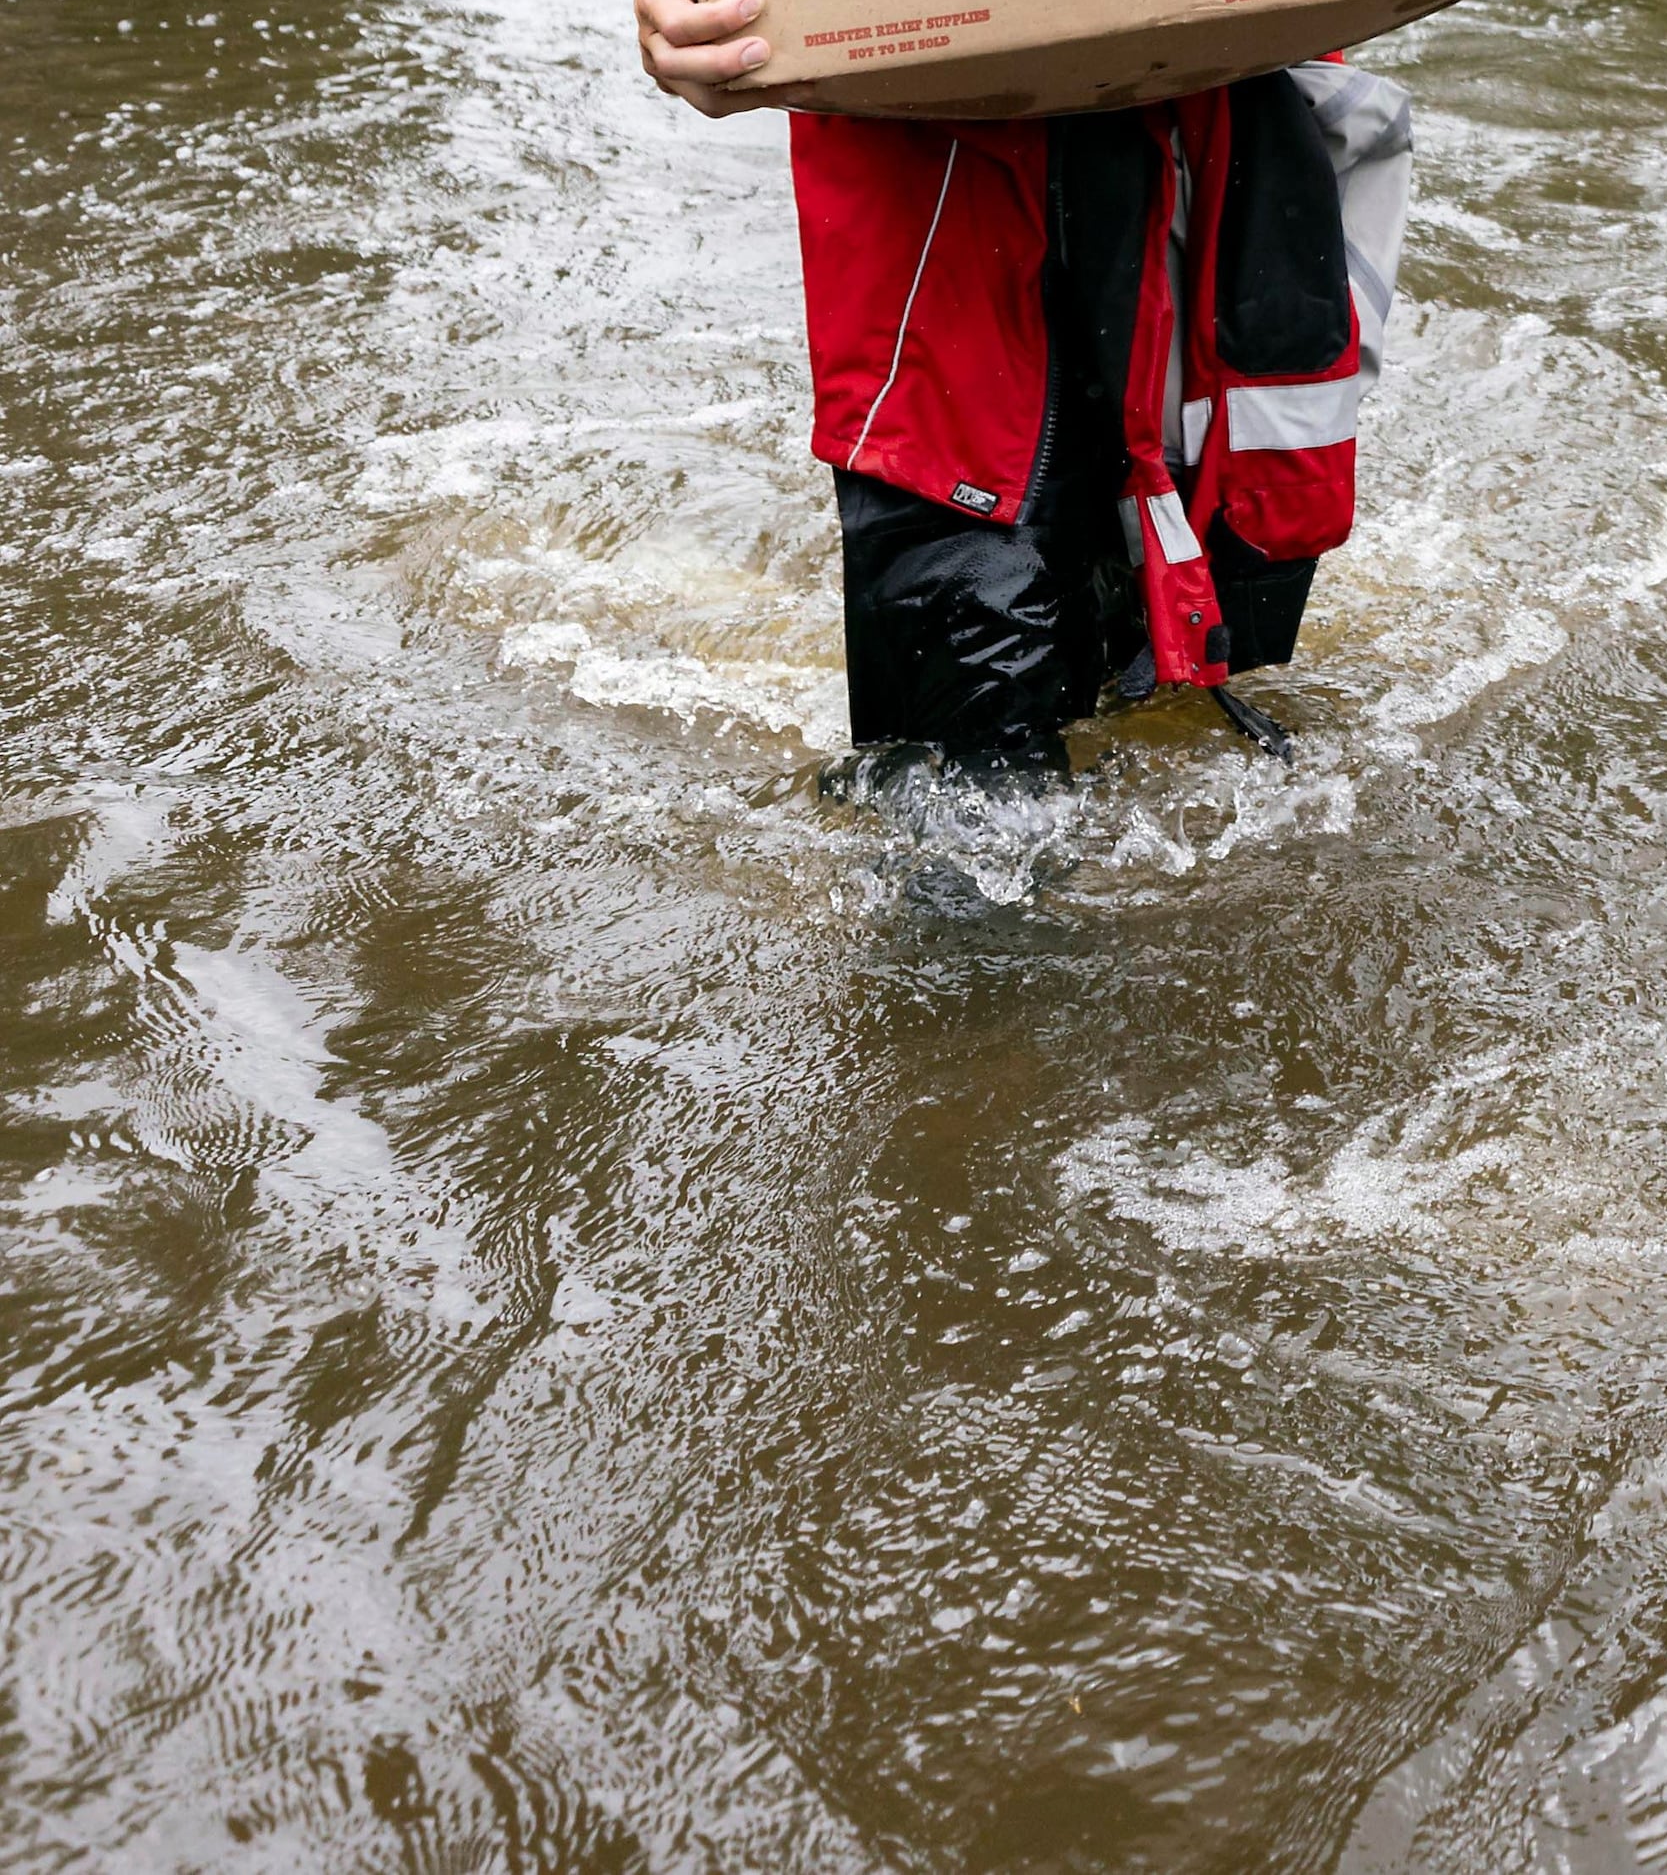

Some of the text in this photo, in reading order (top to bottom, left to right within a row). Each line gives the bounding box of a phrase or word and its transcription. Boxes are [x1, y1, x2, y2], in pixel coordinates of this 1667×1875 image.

[804, 9, 991, 47] DISASTER RELIEF SUPPLIES
[848, 35, 951, 60] NOT TO BE SOLD
